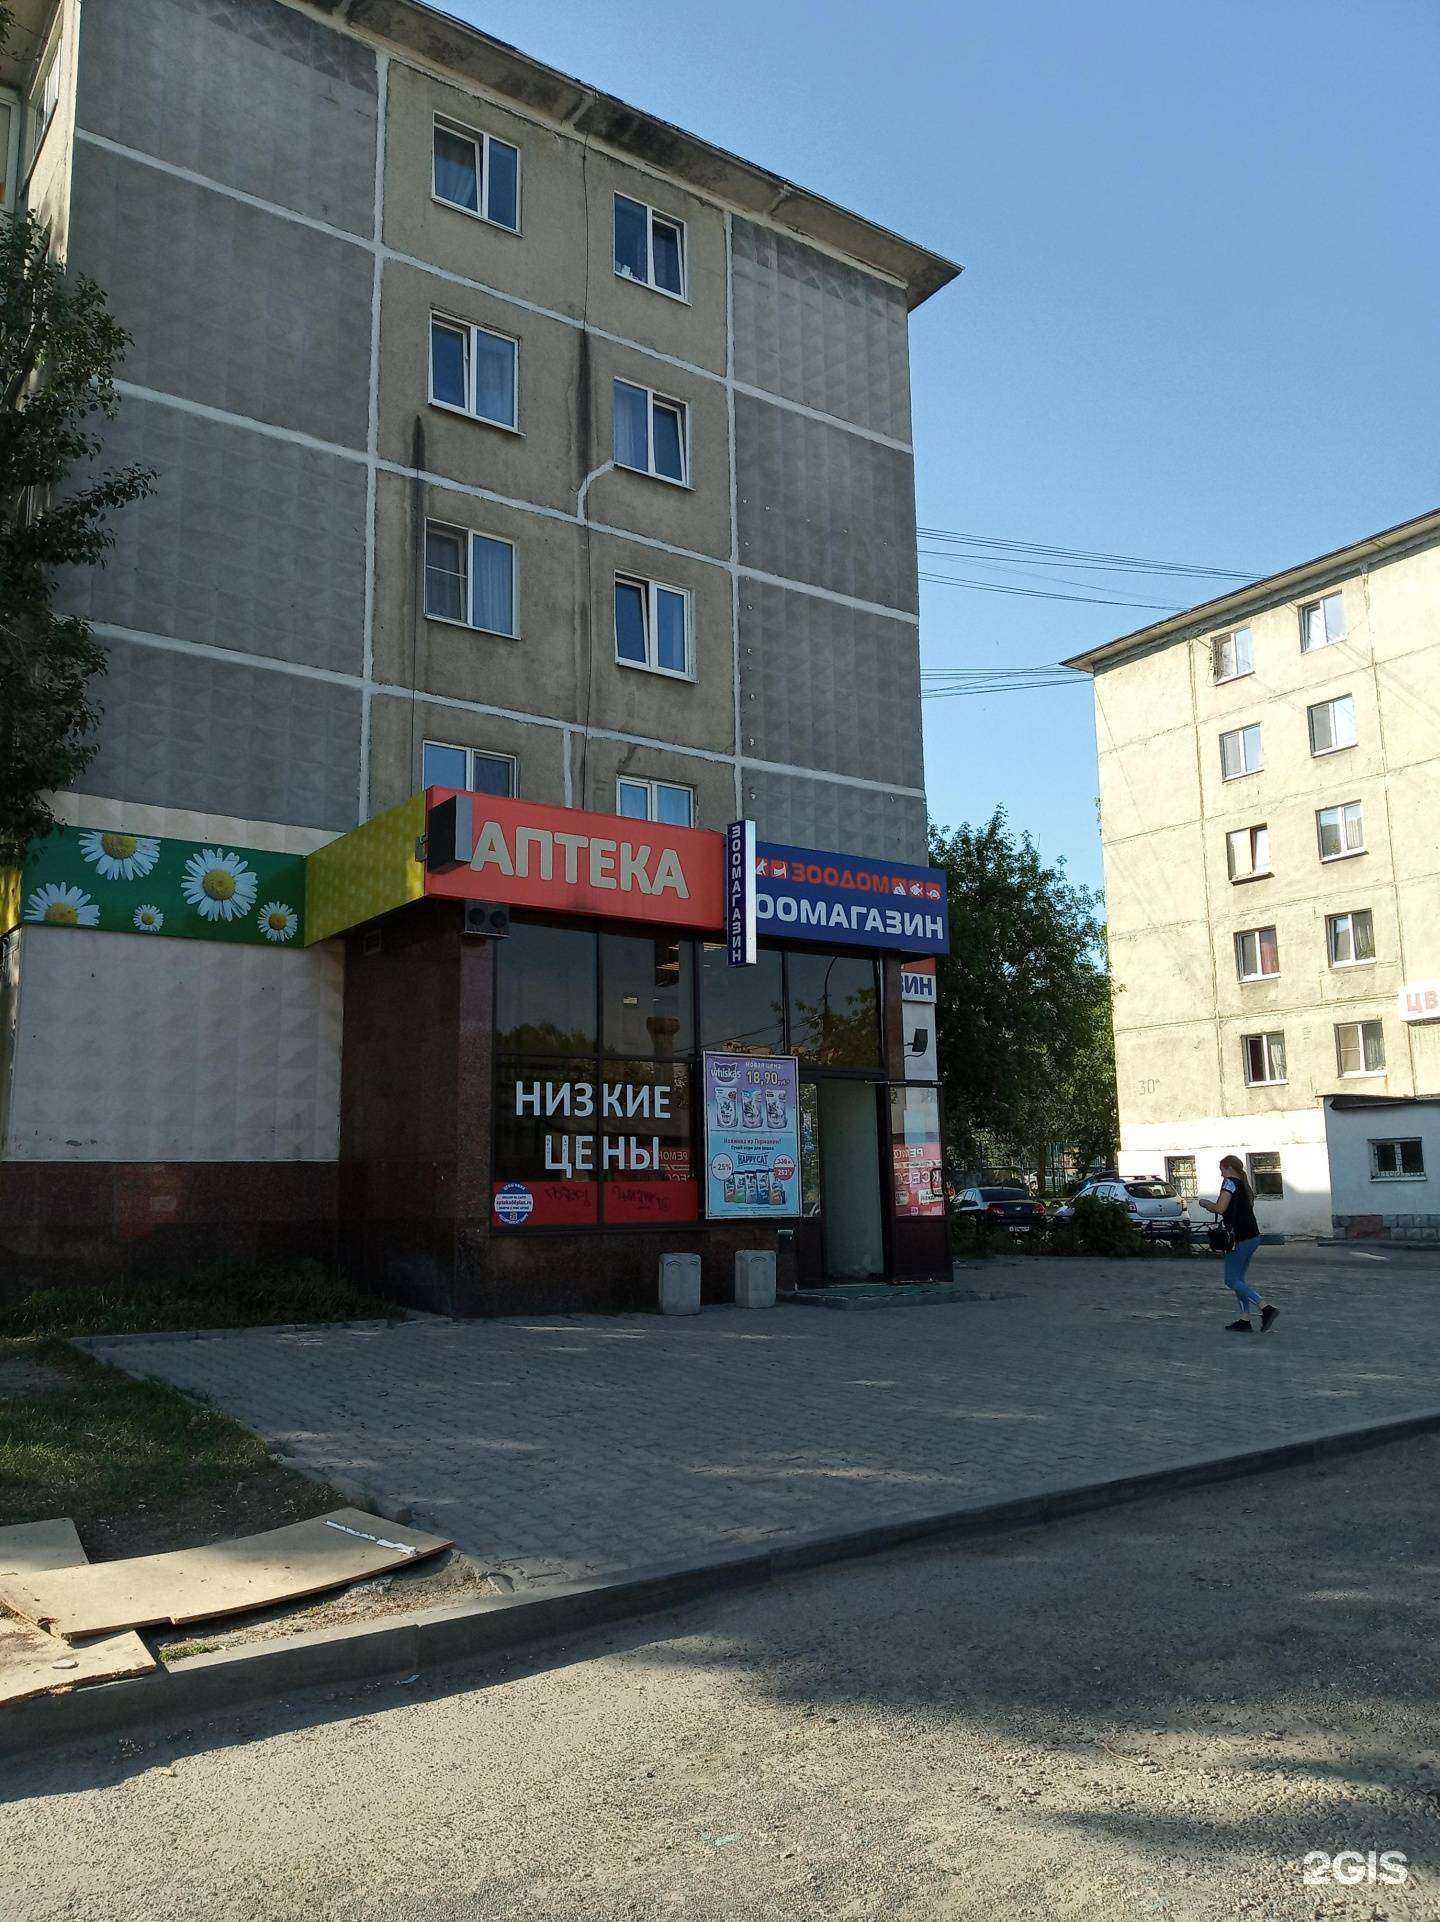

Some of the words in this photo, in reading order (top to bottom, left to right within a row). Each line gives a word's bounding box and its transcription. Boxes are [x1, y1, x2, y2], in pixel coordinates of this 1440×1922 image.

[470, 821, 690, 899] АПТЕКА
[791, 861, 889, 894] ЗООДОМ
[731, 825, 742, 963] ЗООМАГАЗИН
[756, 893, 944, 941] ООМАГАЗИН
[901, 975, 933, 996] ИН
[544, 1134, 660, 1179] ЦЕНЫ
